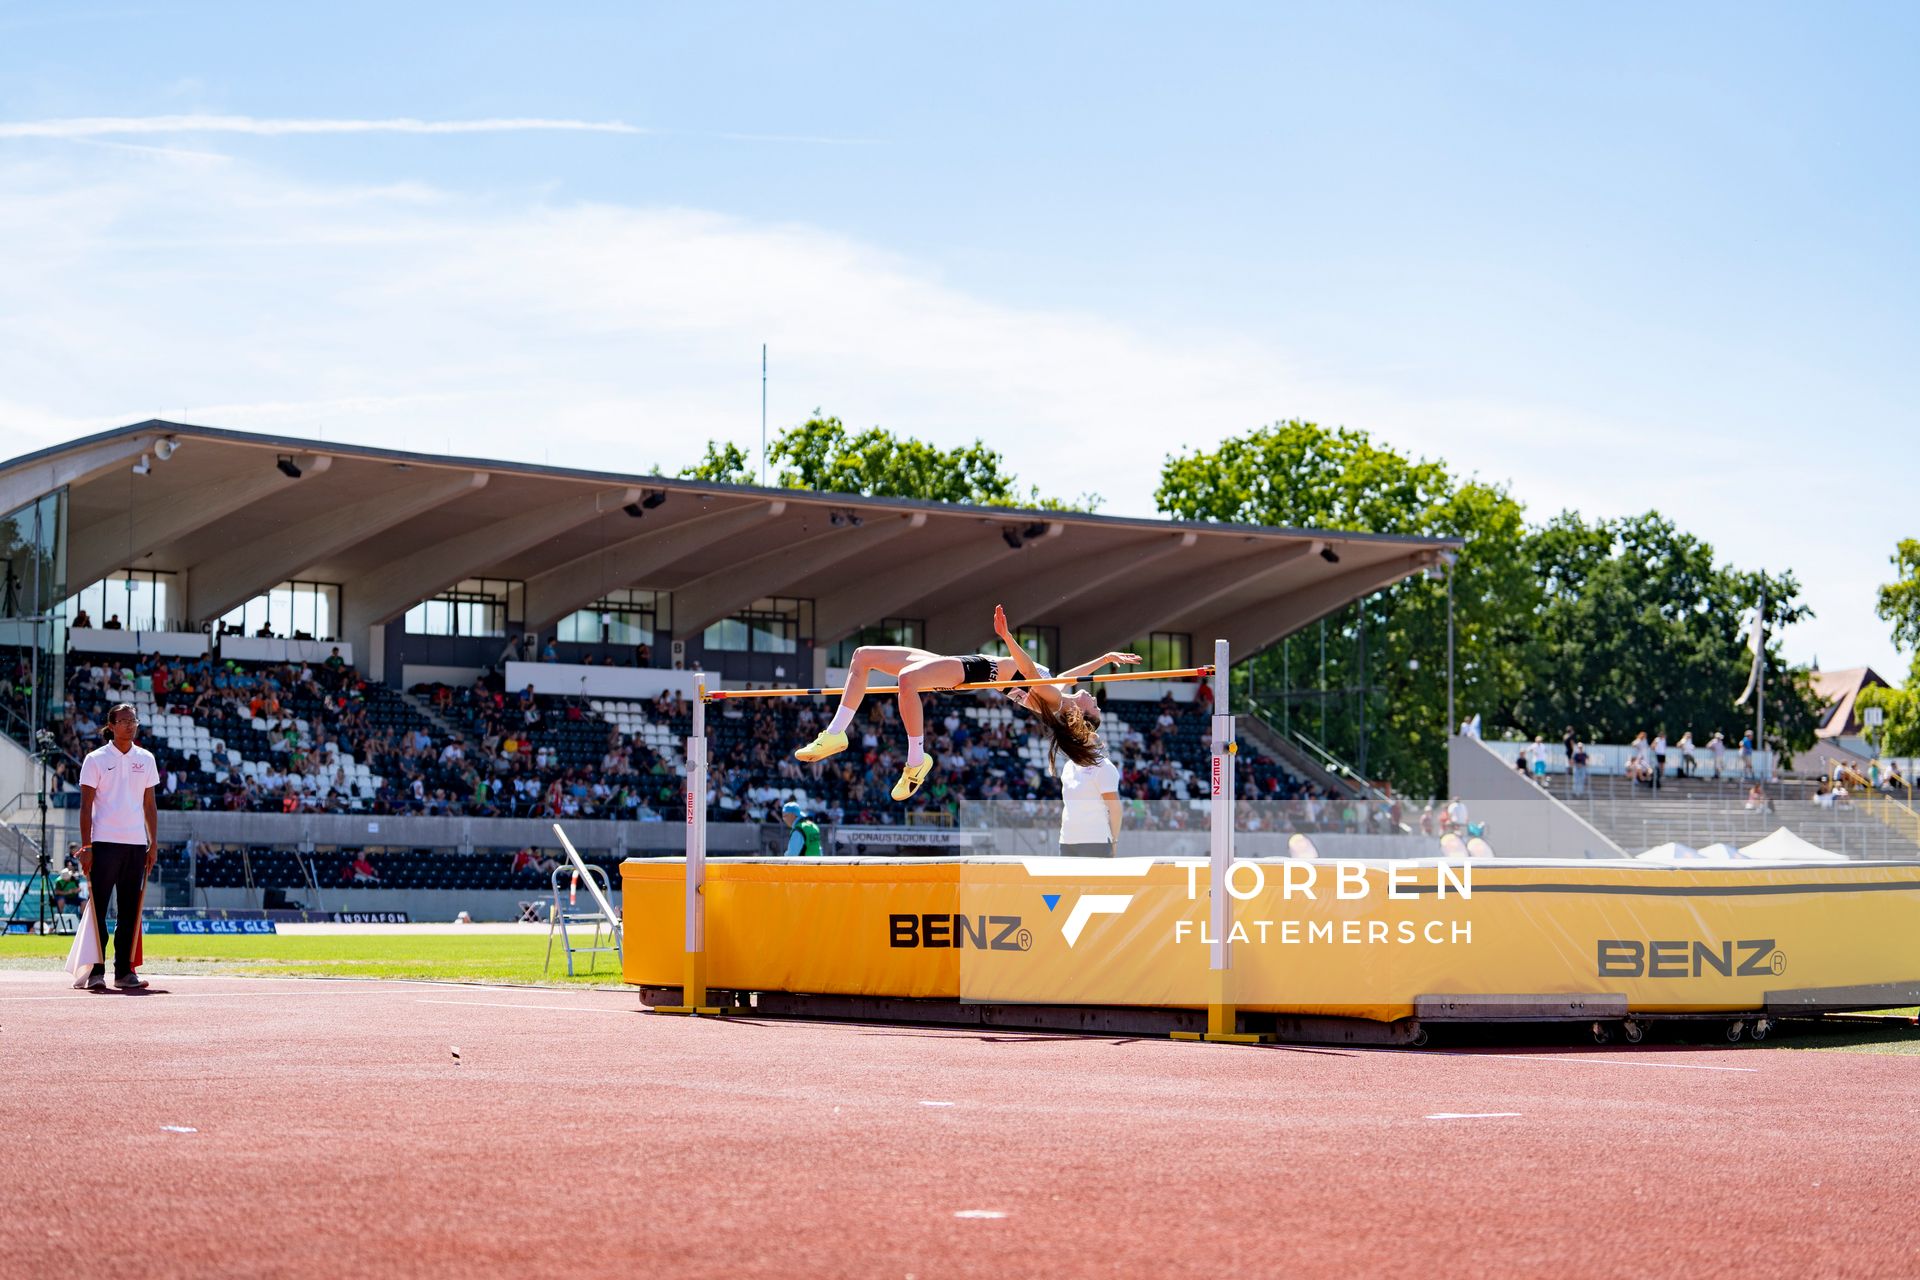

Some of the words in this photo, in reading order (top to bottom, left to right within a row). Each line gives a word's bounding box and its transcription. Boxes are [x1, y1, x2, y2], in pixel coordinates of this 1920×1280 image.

[1213, 757, 1221, 796] BENZ
[852, 832, 926, 843] DONAUSTADION
[929, 834, 950, 843] ULM
[343, 913, 406, 923] NOVAFON
